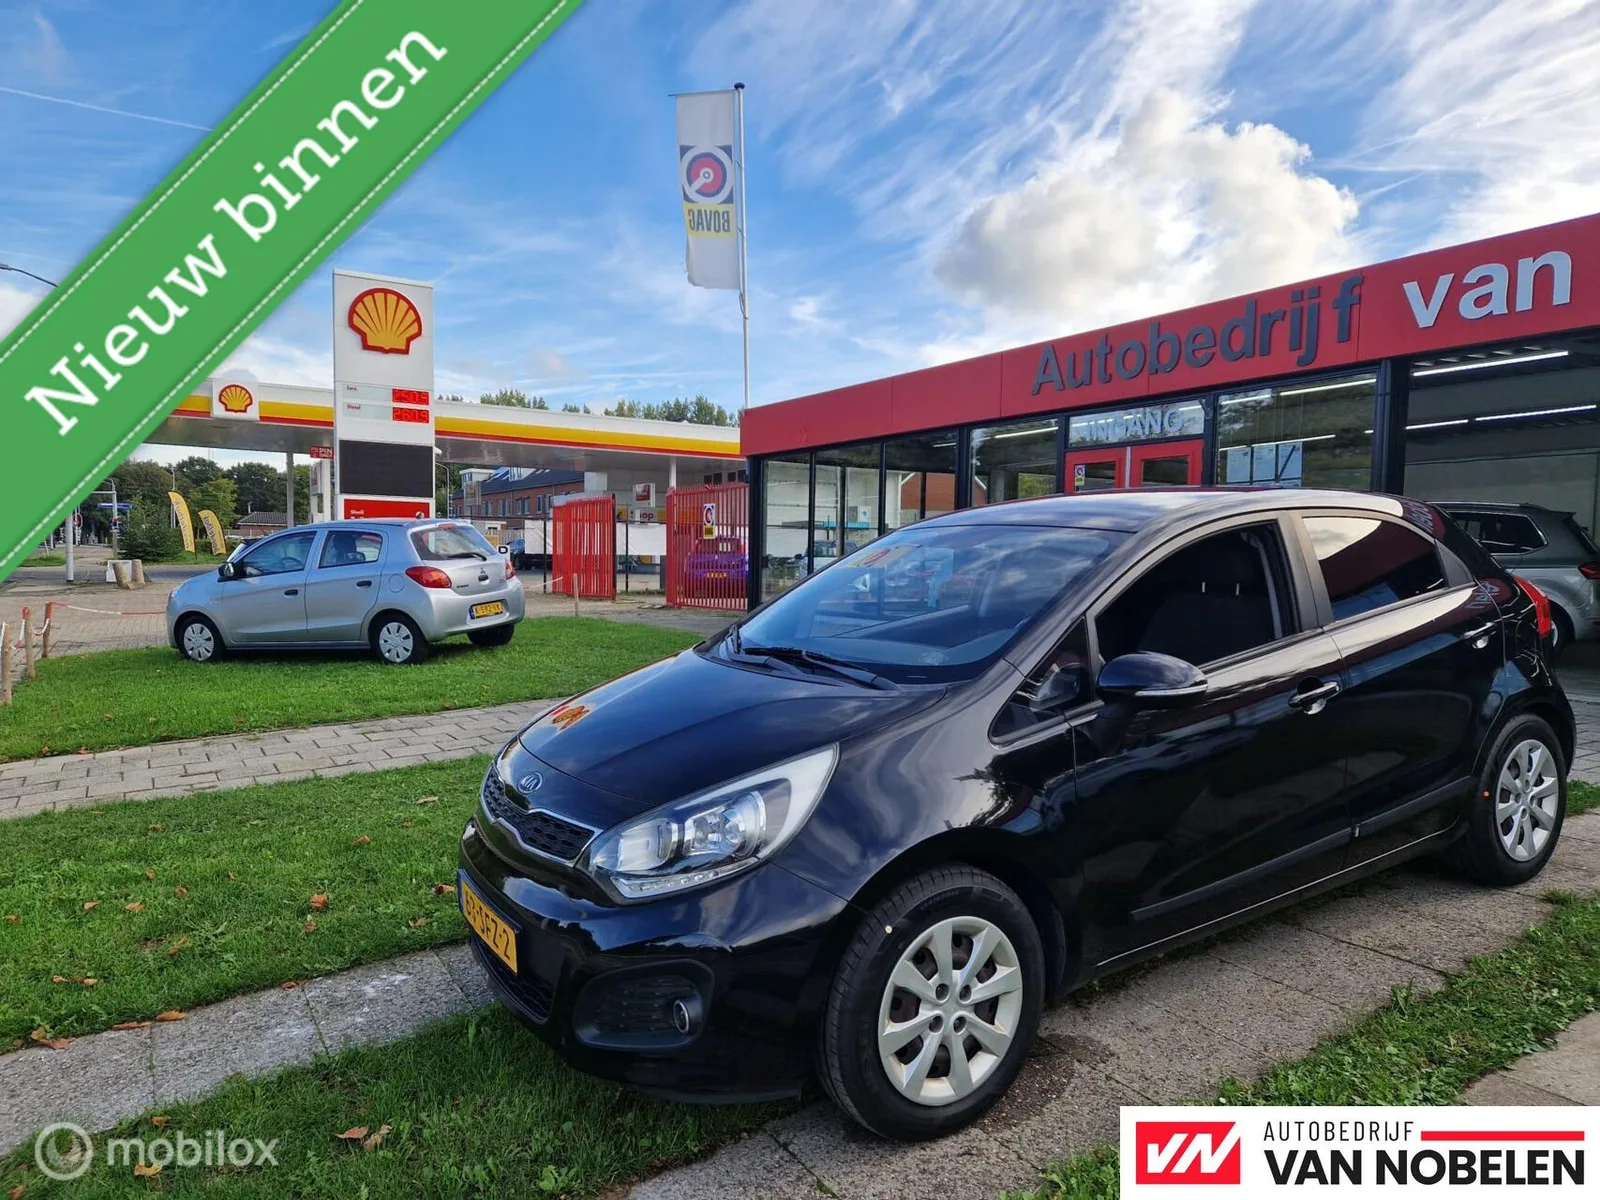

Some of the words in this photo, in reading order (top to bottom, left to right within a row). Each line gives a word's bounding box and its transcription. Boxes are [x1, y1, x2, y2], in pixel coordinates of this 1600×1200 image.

[1031, 275, 1364, 395] Autobedrijf
[1403, 250, 1573, 328] van
[1089, 408, 1183, 441] INGANG
